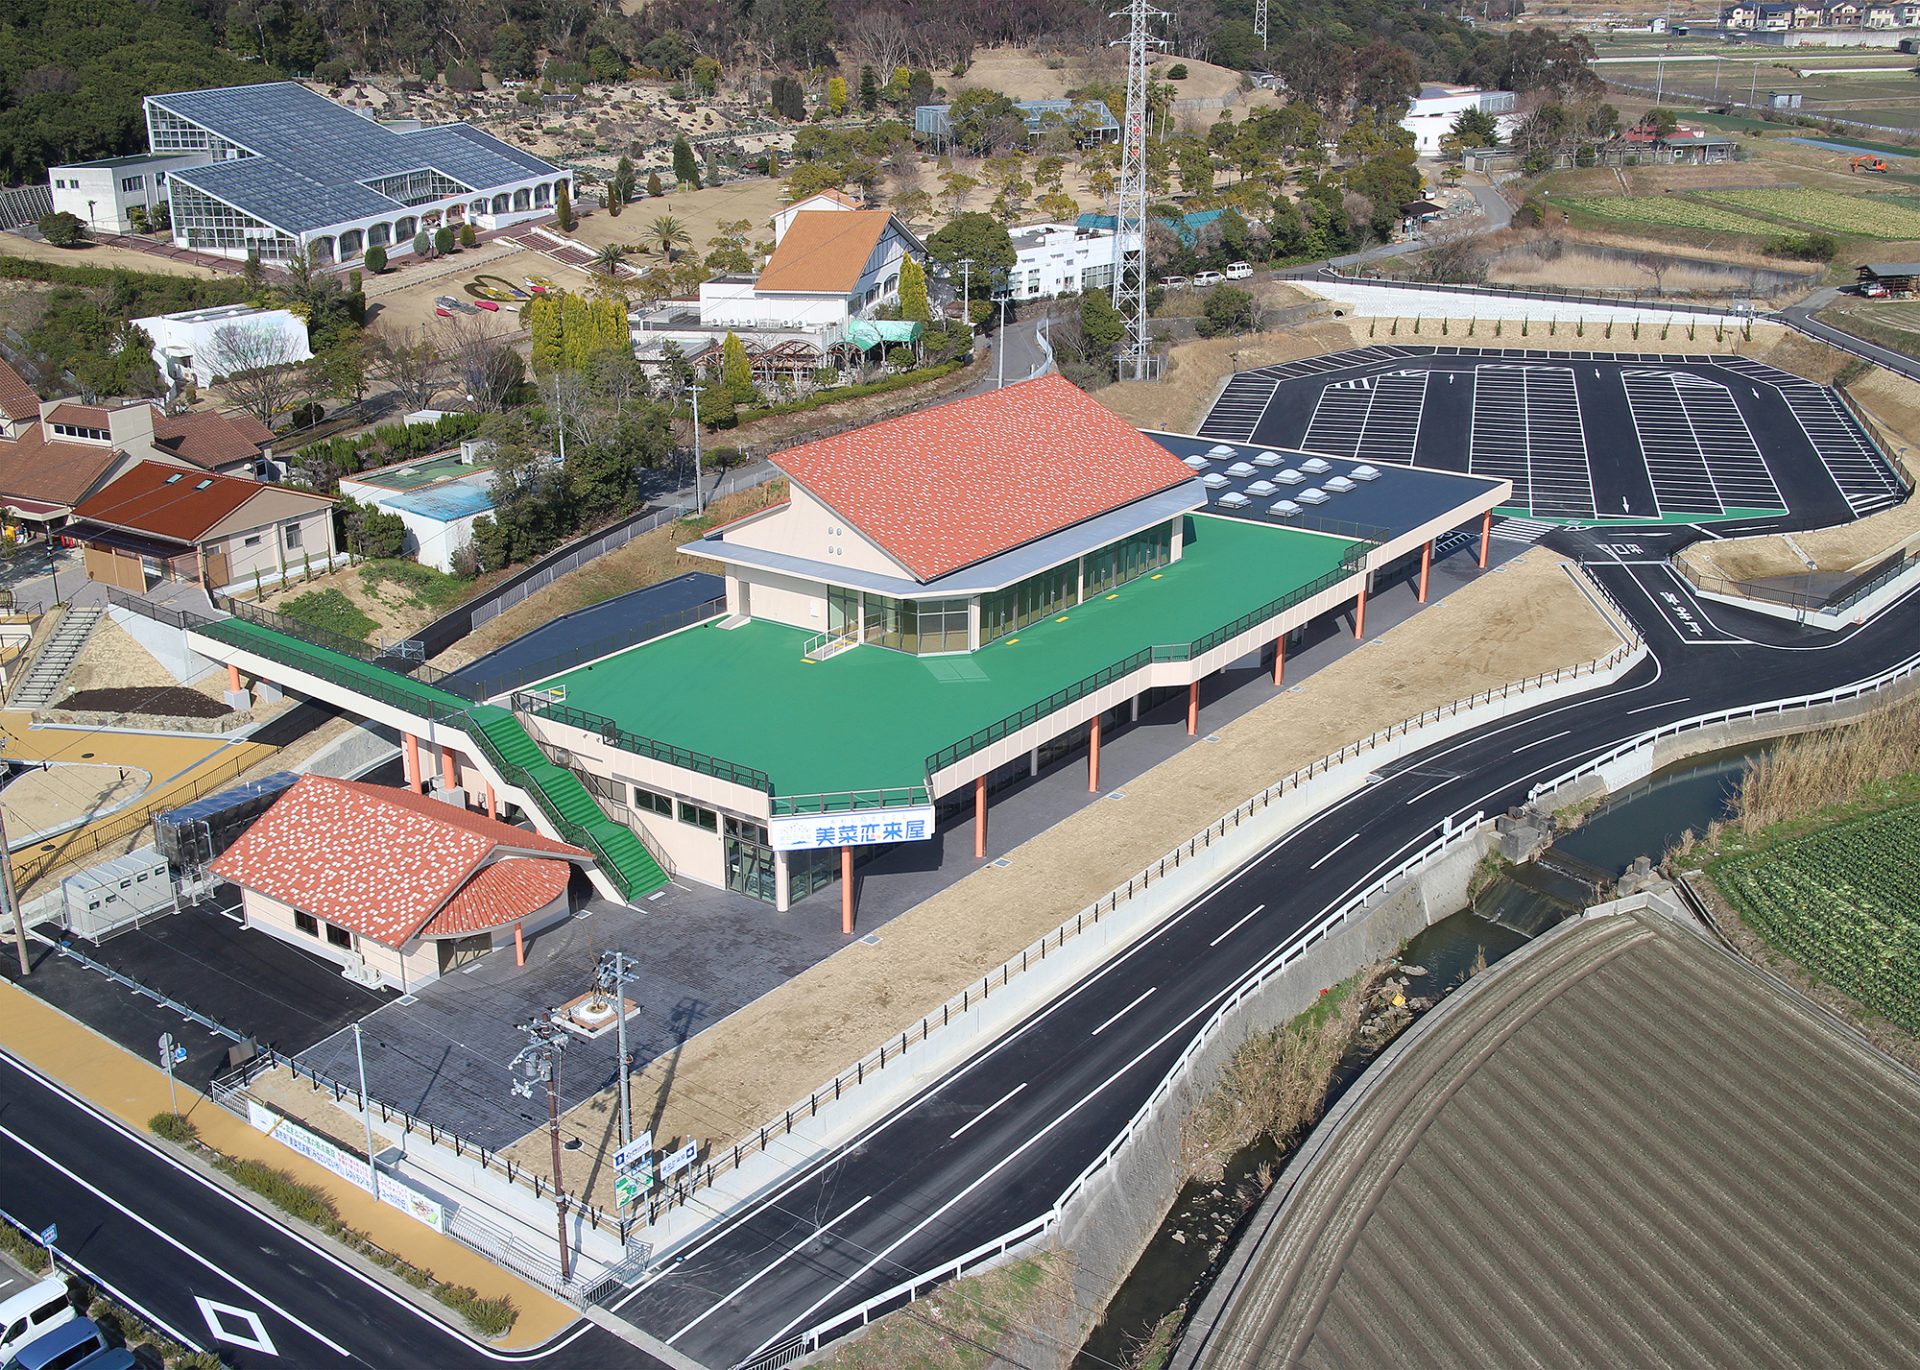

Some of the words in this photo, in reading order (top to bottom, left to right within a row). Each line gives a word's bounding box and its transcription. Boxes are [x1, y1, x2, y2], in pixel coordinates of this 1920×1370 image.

[1612, 543, 1644, 555] 出口
[1660, 592, 1703, 637] 止まれ
[815, 820, 925, 846] 美菜恋来屋
